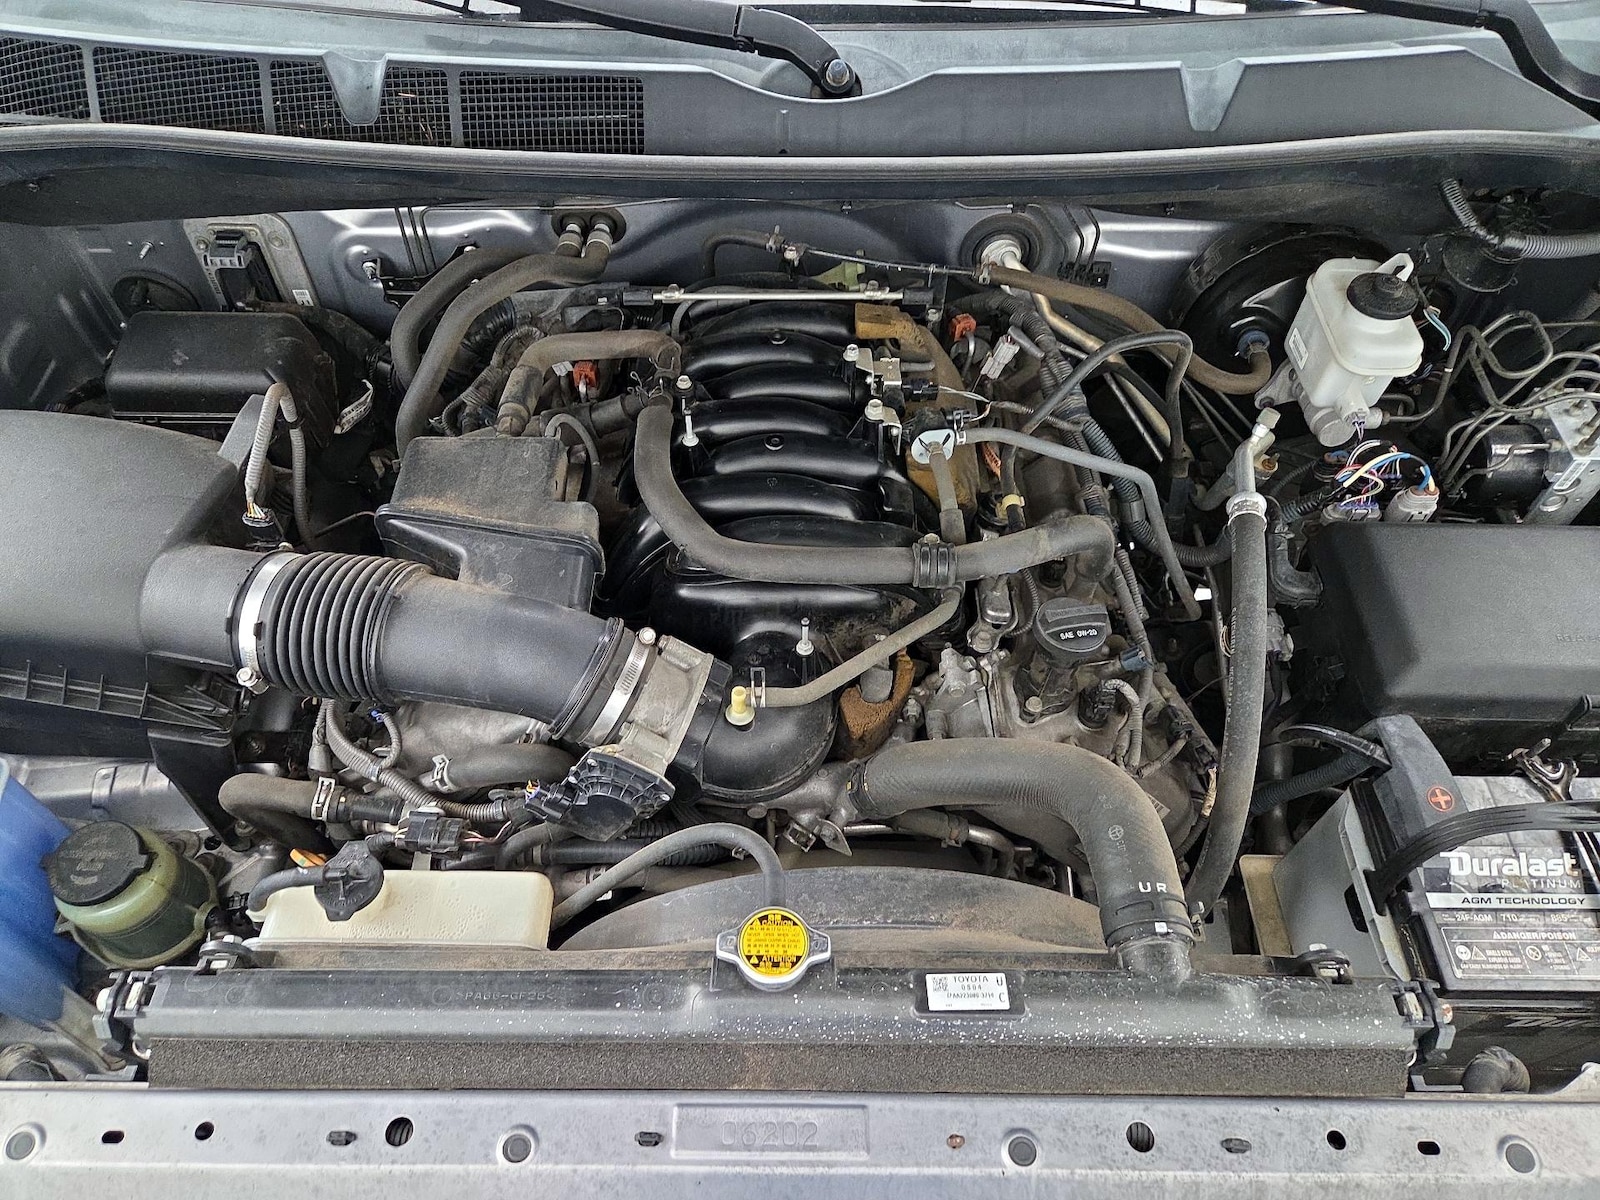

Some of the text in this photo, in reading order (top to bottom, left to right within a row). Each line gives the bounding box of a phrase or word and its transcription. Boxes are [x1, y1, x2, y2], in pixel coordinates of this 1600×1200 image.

[1060, 629, 1098, 640] SAE 0W-20
[1439, 852, 1579, 877] Duralast
[1501, 878, 1582, 889] PLATINUM
[1461, 897, 1586, 905] AGM TECHNOLOGY
[1455, 914, 1493, 922] 24F-AGM
[1499, 931, 1576, 940] DANGER/POISON
[953, 975, 989, 983] TOYOTA
[721, 1120, 819, 1148] 06202
